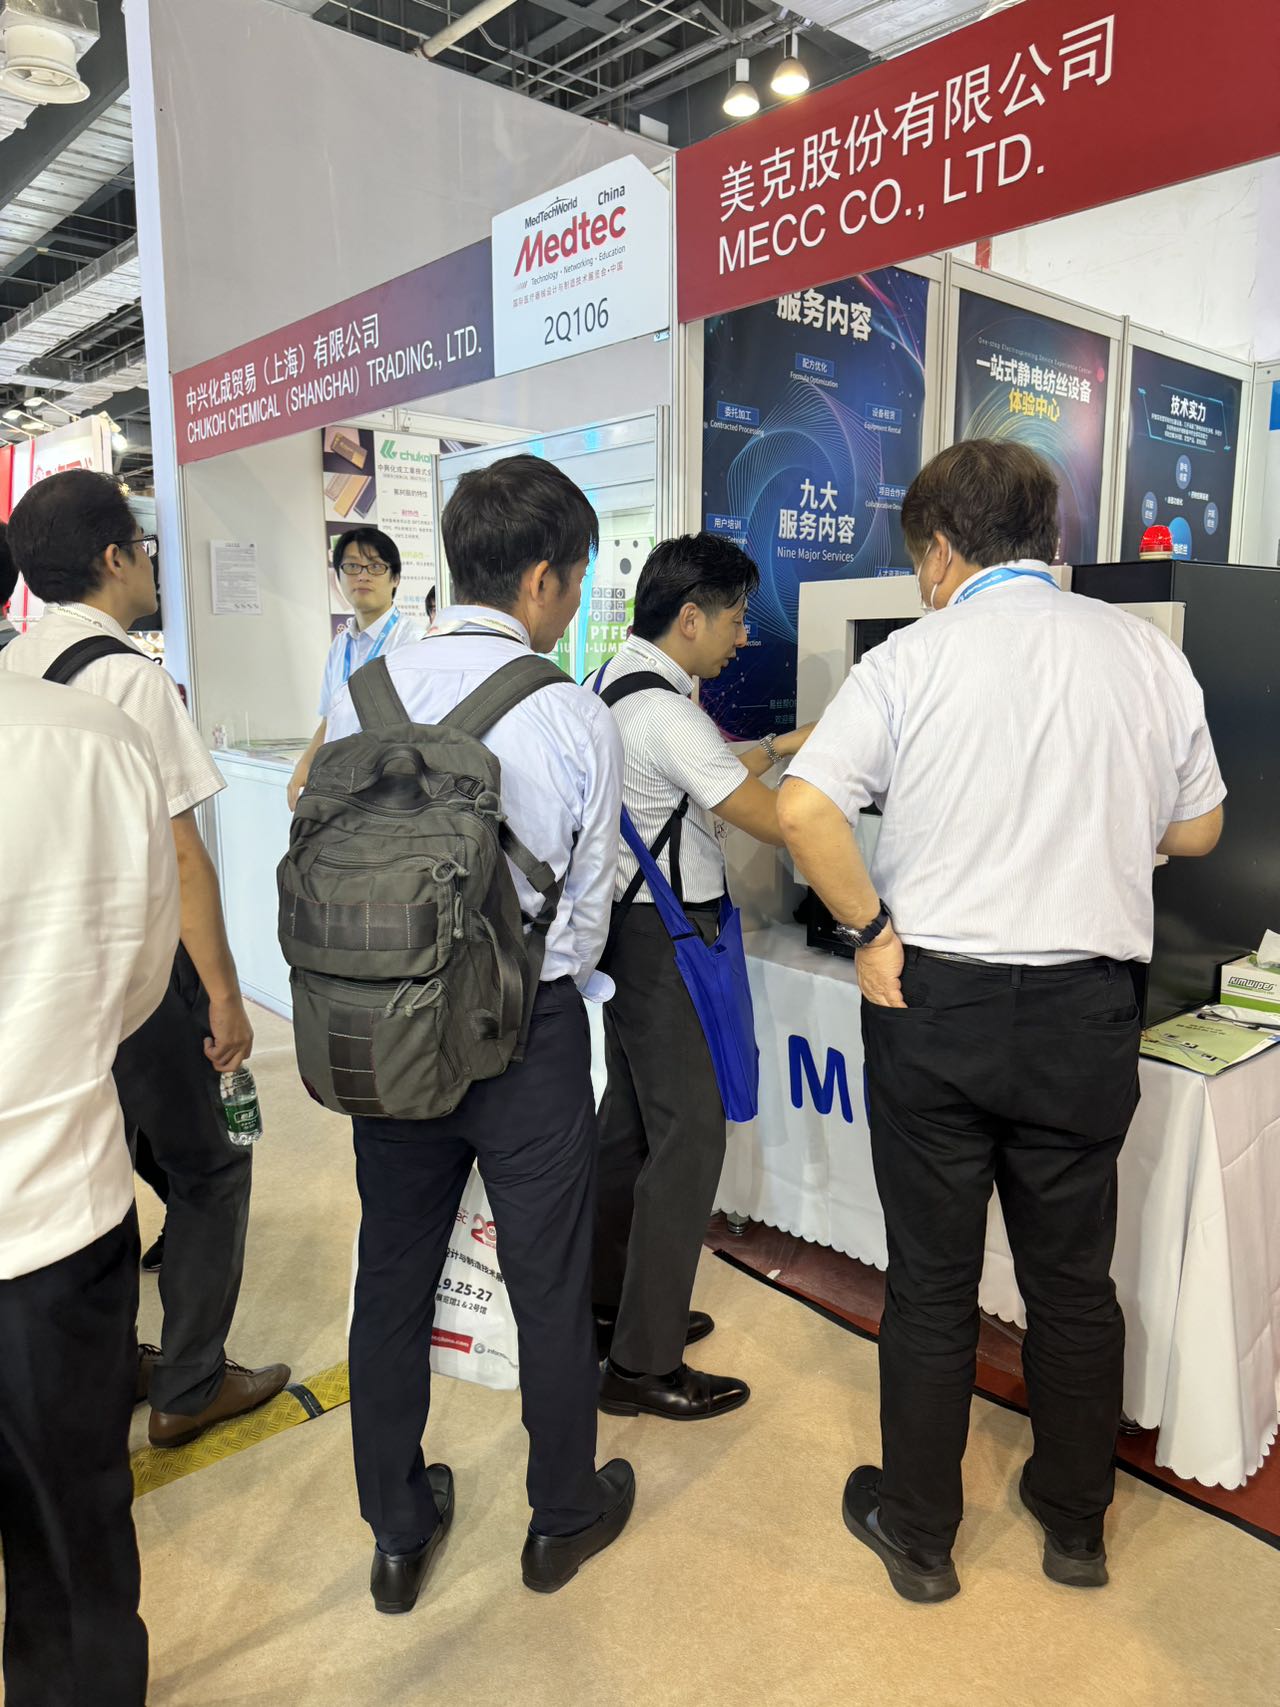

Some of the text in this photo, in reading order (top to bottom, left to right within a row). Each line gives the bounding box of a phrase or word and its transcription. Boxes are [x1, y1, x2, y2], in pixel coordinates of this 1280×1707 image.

[720, 14, 1115, 222] 美克股份有限公司
[525, 185, 625, 230] MedTechWorld China
[719, 134, 1045, 275] MECC CO., LTD.
[514, 206, 626, 277] Medtec
[531, 245, 626, 286] Technology Networking Education
[544, 297, 609, 345] 2Q106
[777, 288, 872, 341] 服务内容
[187, 411, 227, 443] CHUKOH
[228, 399, 281, 431] CHEMICAL
[366, 340, 442, 387] TRADING.,
[446, 325, 482, 363] LTD.
[790, 371, 809, 383] Formula
[802, 358, 828, 374] 配方优化
[976, 354, 1092, 403] 一站式静电纺丝设备
[724, 406, 752, 421] 委托加工
[1009, 388, 1061, 423] 体验中心
[1171, 394, 1206, 422] 技术实力
[710, 420, 738, 432] Contracted
[800, 478, 839, 511] 九大
[778, 508, 856, 544] 服务内容
[777, 546, 855, 563] Nine Major Services
[591, 625, 626, 640] PTFE
[788, 1034, 870, 1128] M
